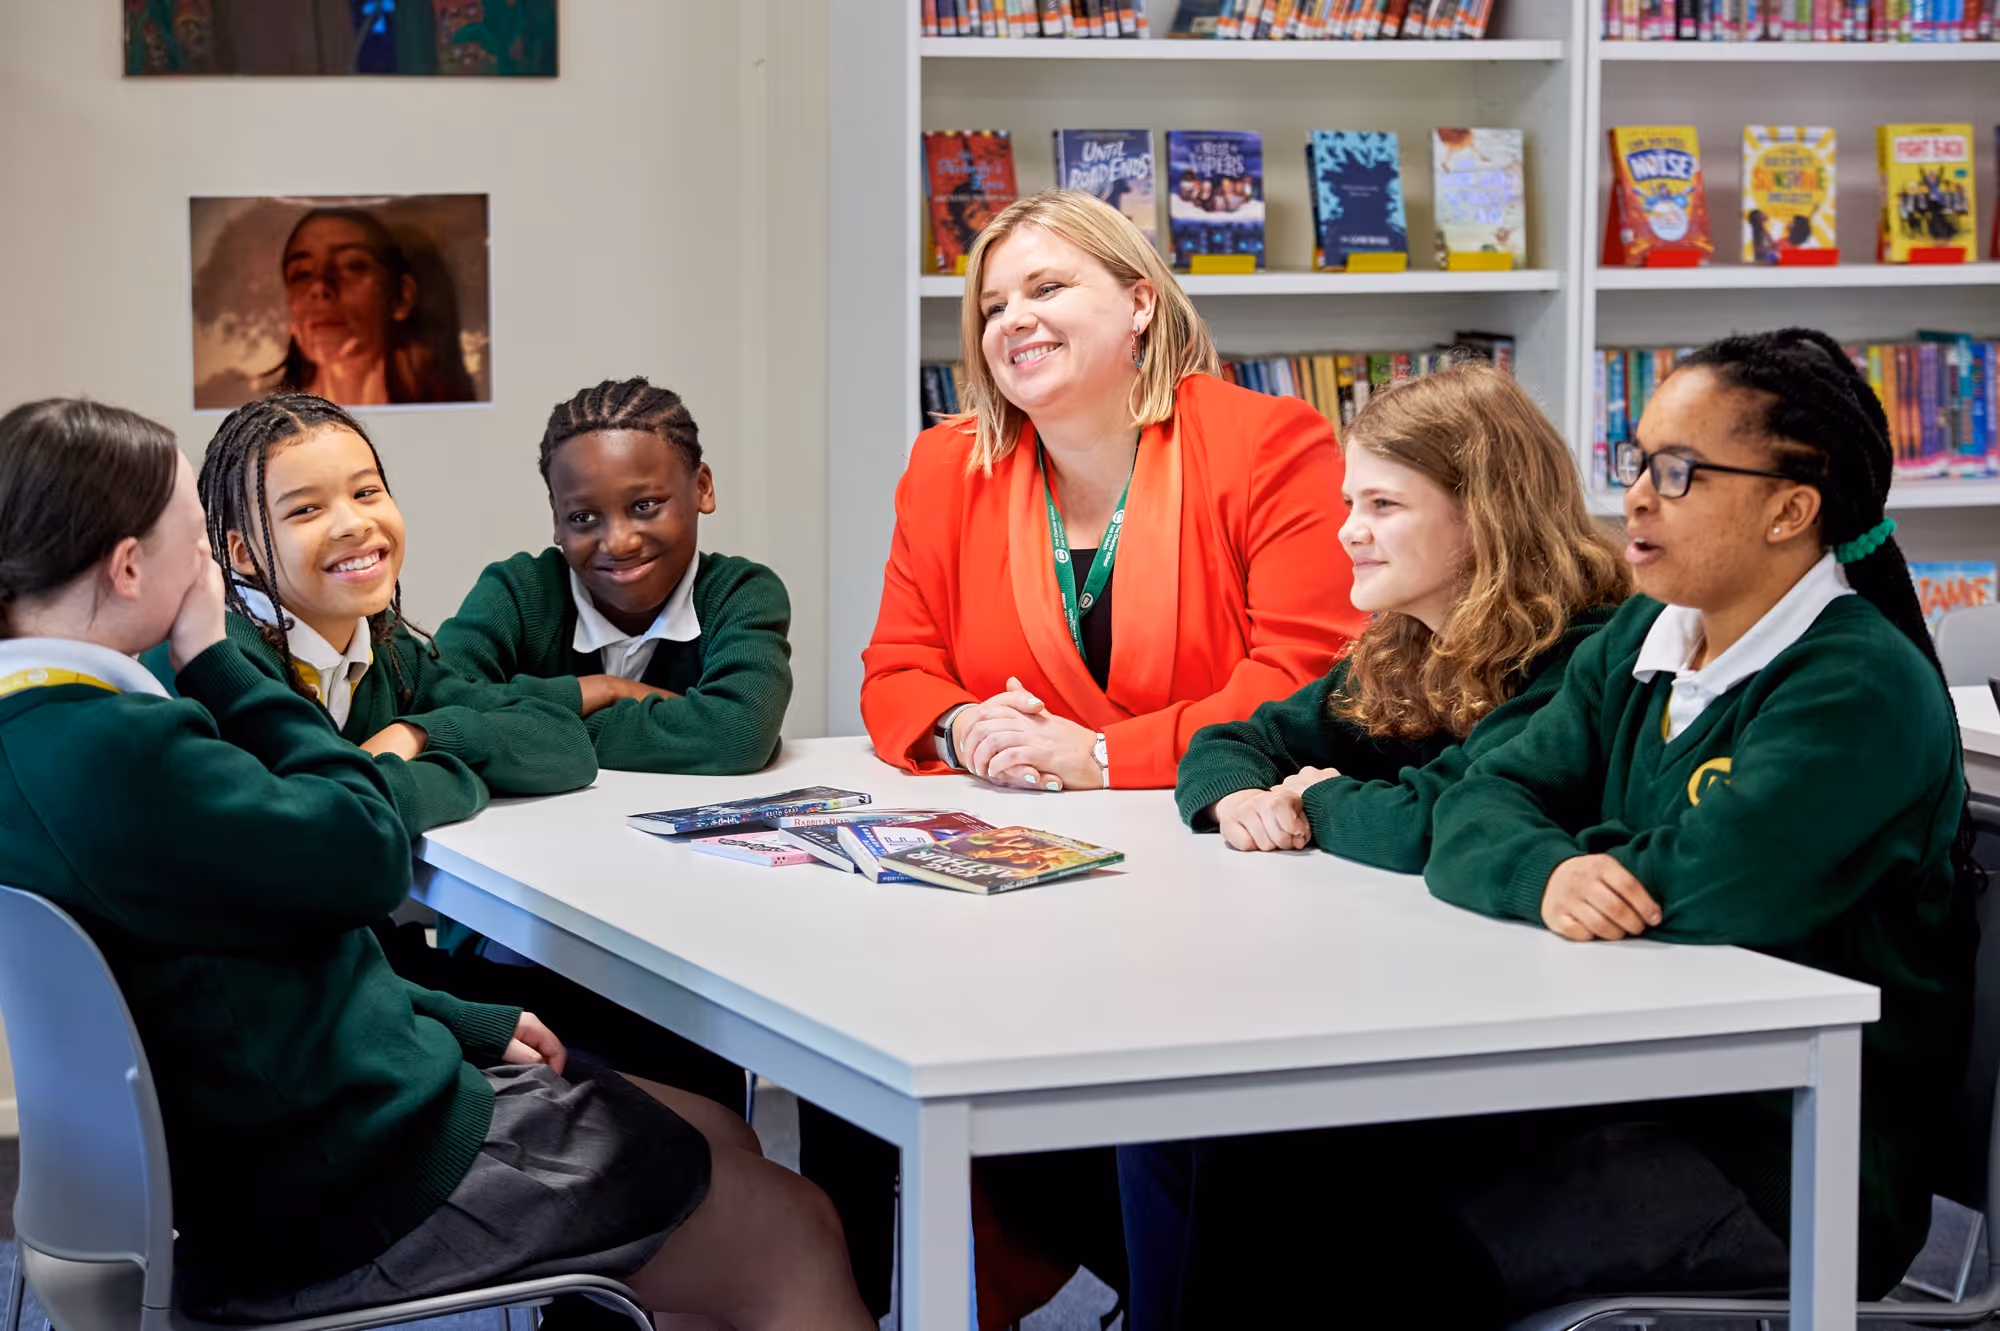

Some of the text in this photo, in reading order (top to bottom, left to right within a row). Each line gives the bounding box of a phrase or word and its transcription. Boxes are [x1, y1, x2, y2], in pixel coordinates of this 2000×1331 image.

[1082, 140, 1126, 162] UNTIL
[1108, 153, 1153, 181] ENDS
[766, 806, 799, 818] KEITH GRAY
[906, 851, 1023, 878] ARTHUR
[921, 862, 981, 877] KING
